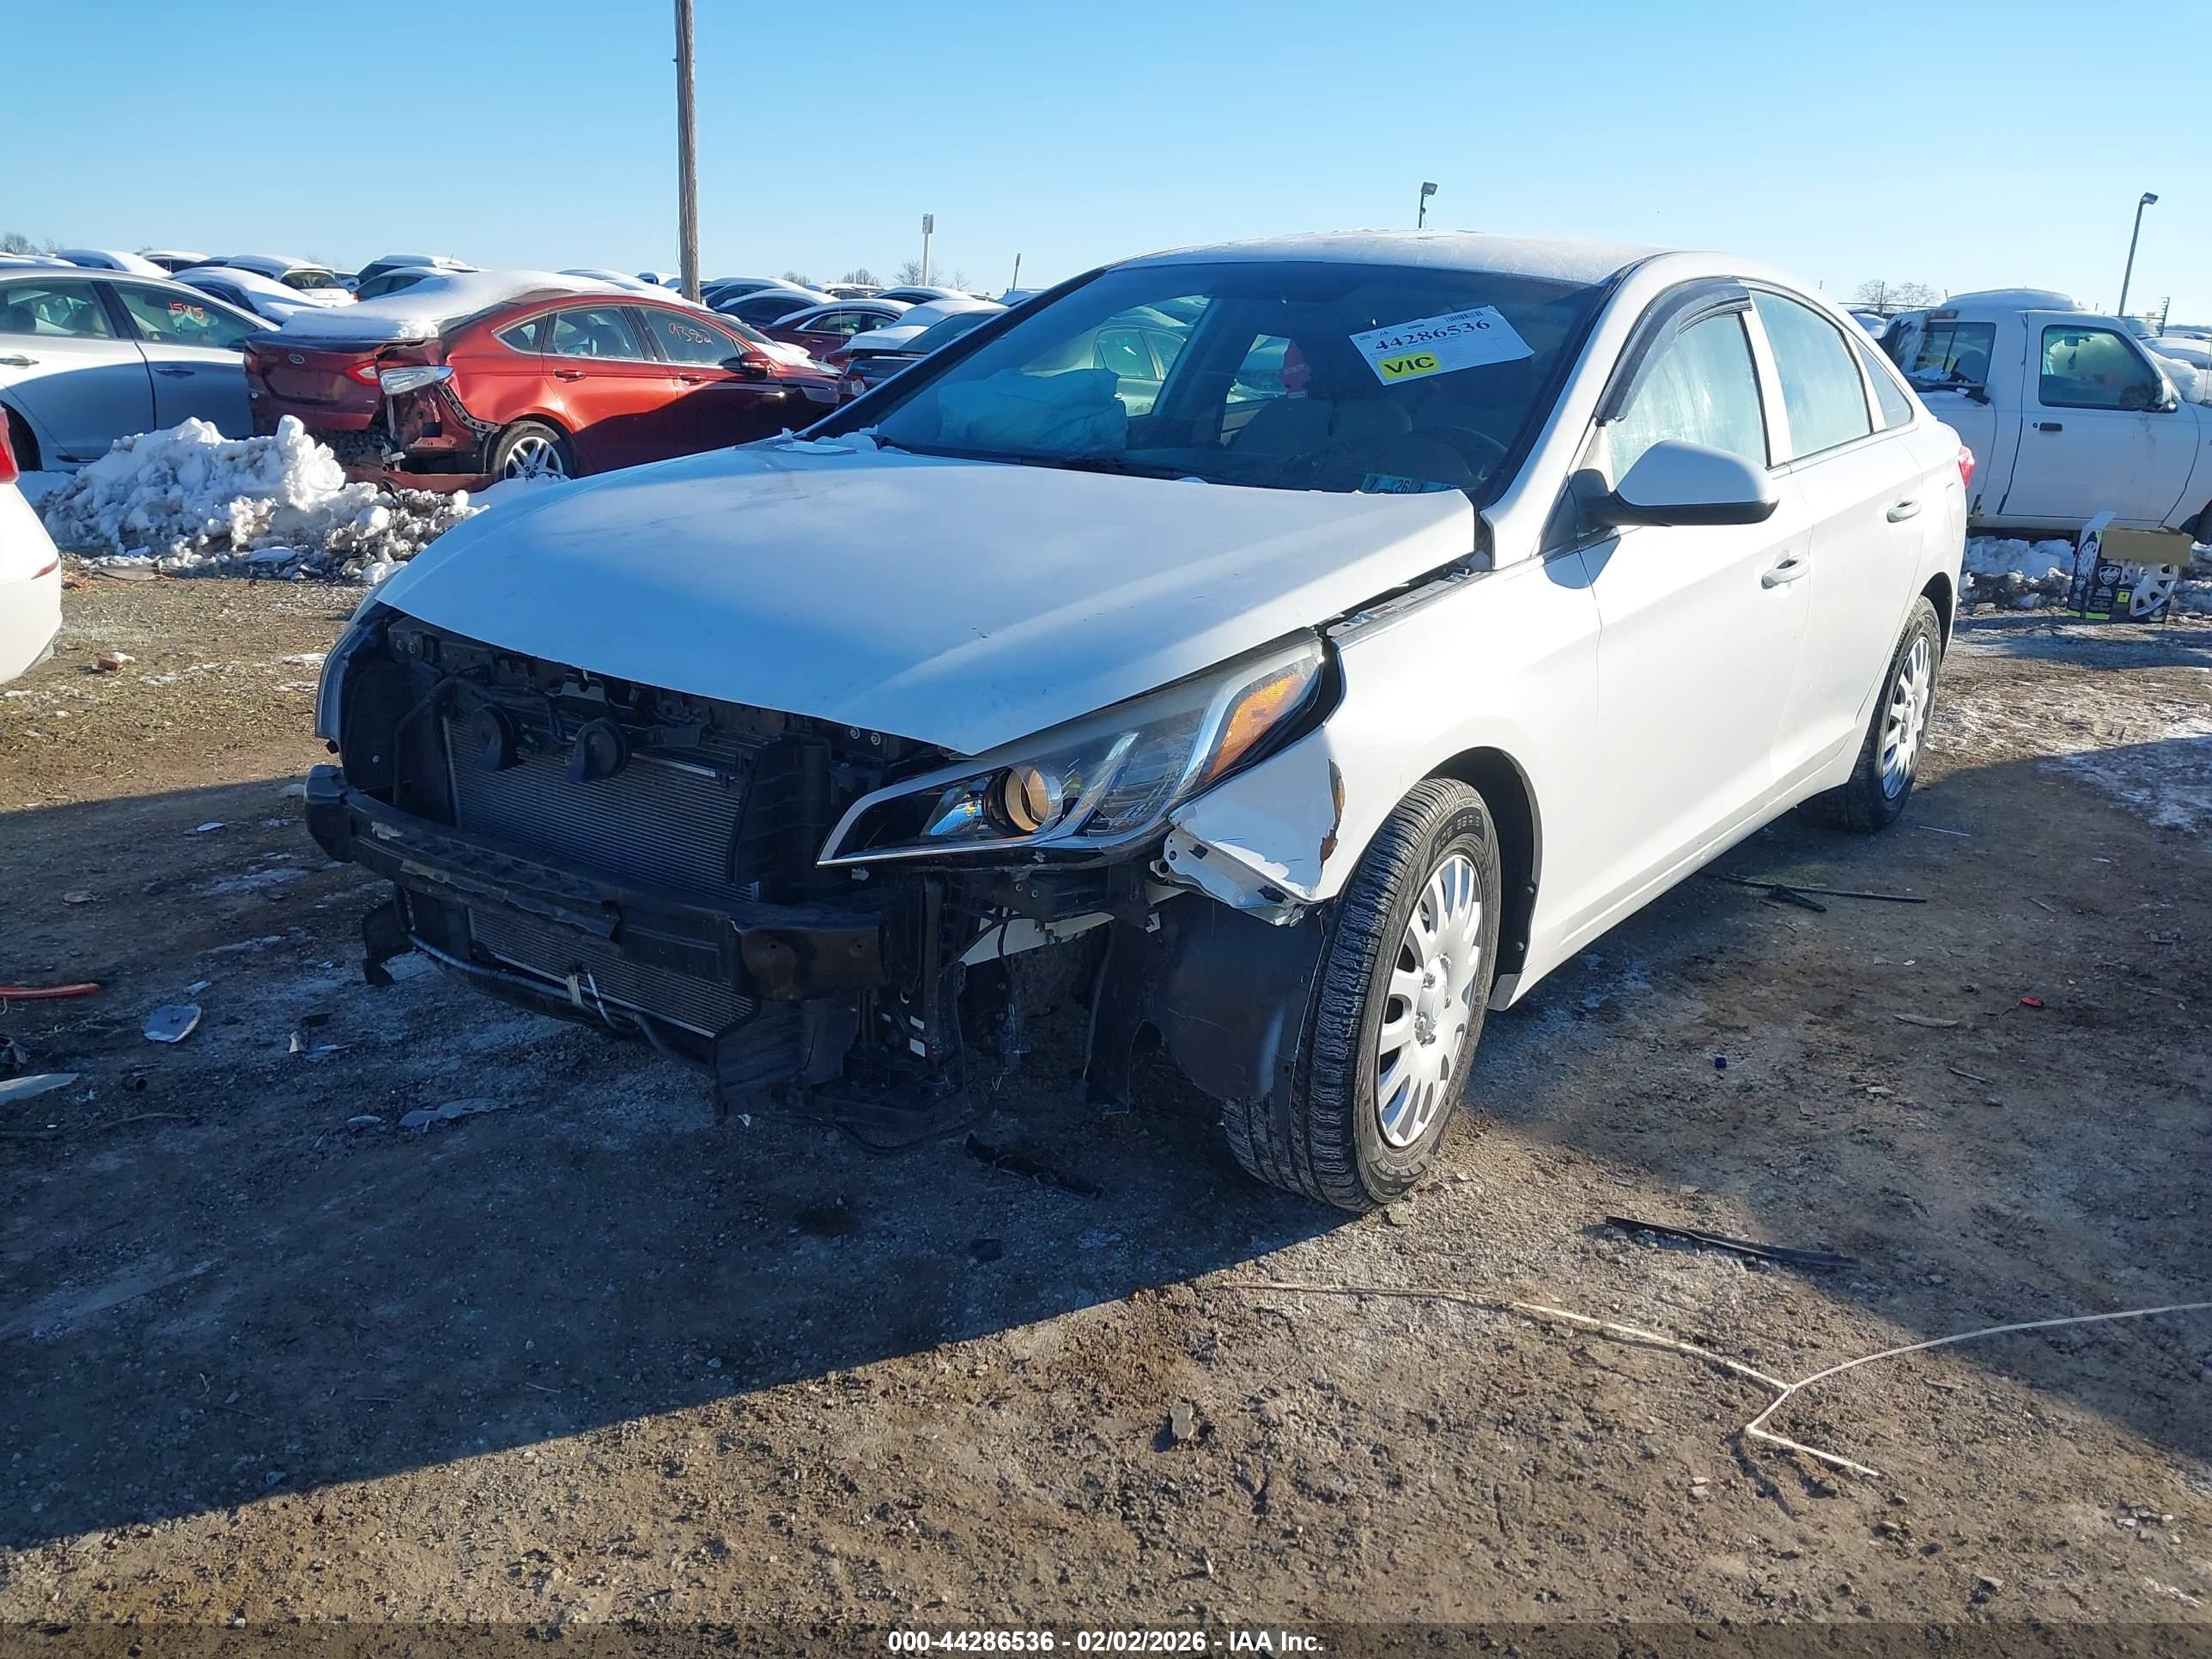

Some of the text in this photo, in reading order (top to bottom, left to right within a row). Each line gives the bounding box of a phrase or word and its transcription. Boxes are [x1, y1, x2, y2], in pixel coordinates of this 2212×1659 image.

[667, 322, 714, 345] 9382
[1375, 319, 1491, 349] 44286536
[1383, 356, 1435, 374] VIC
